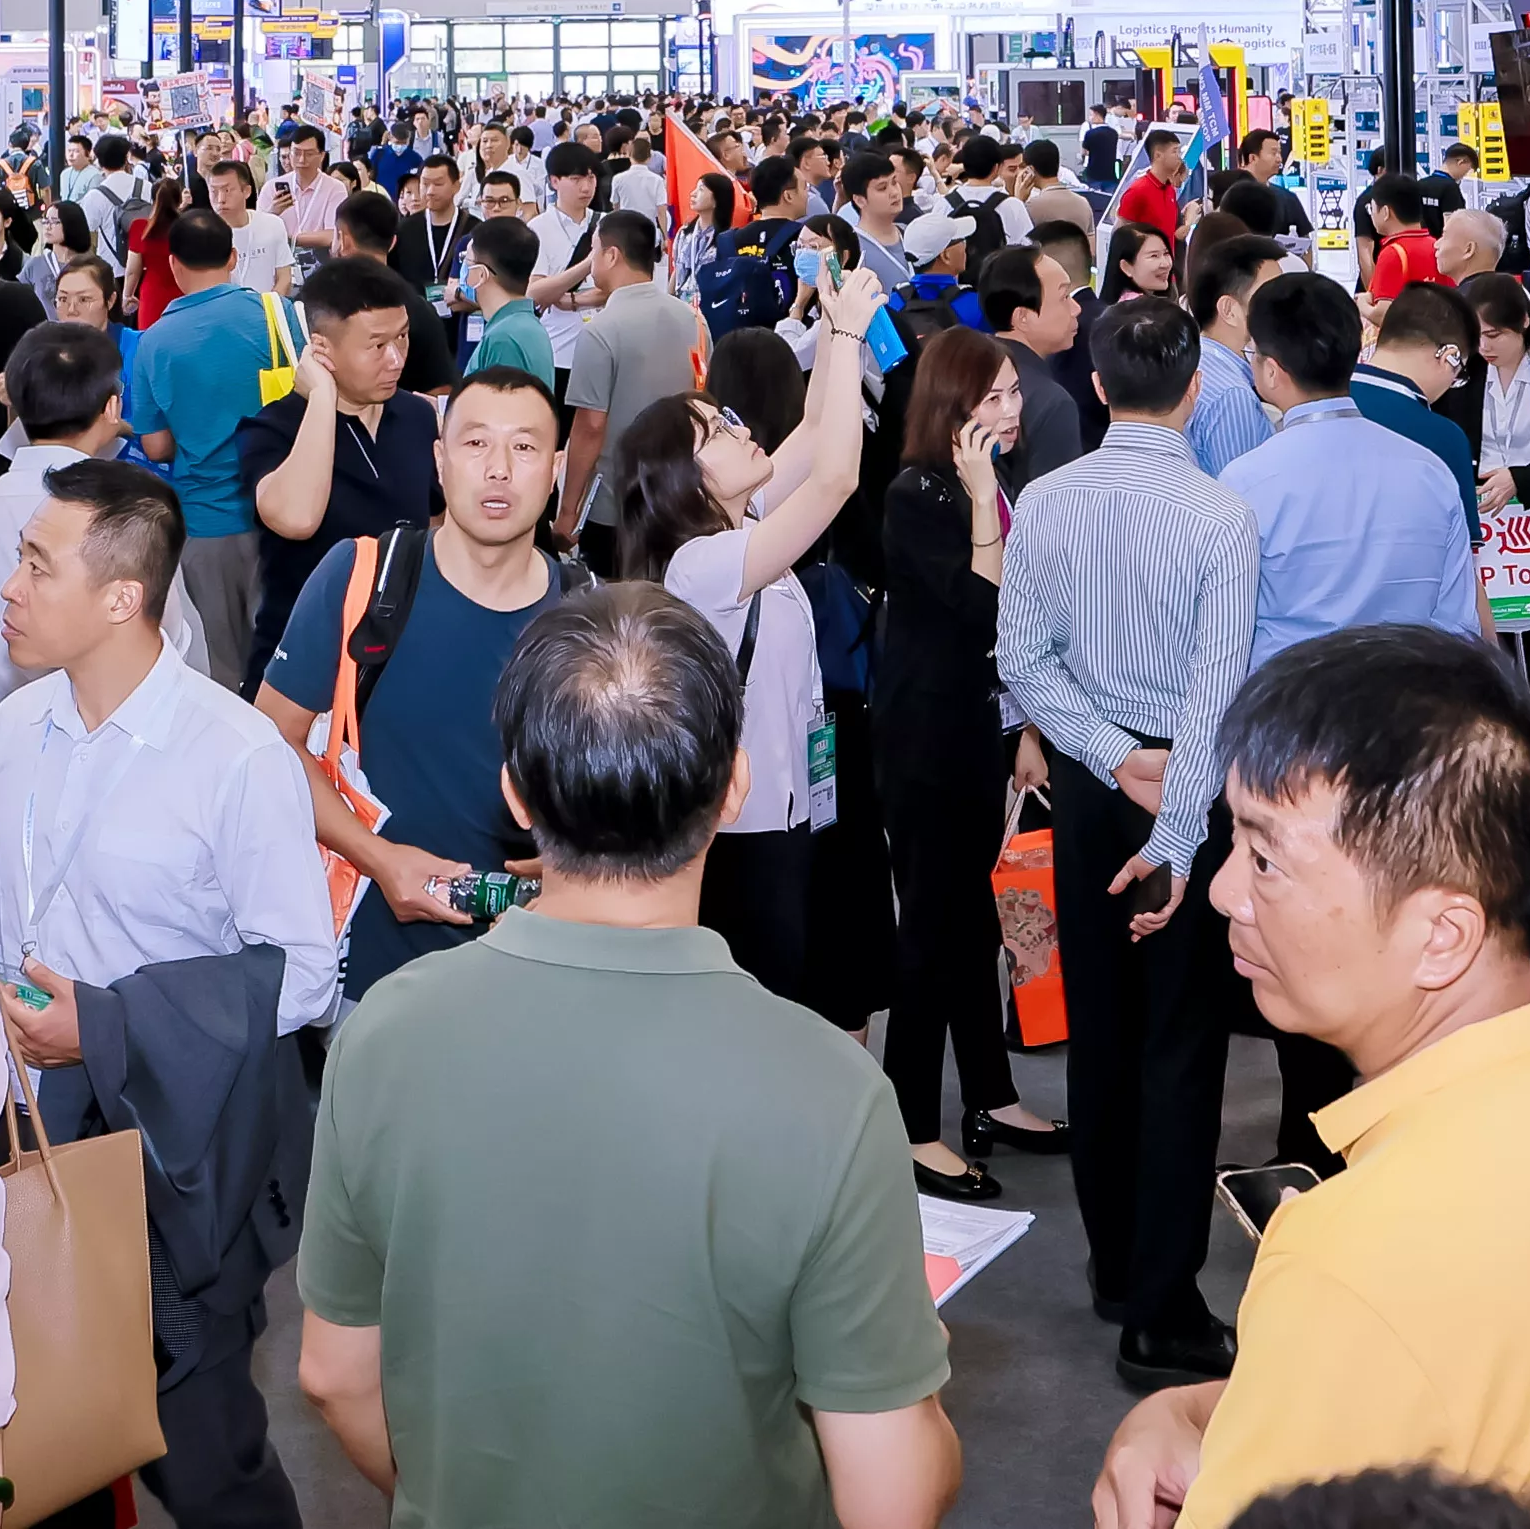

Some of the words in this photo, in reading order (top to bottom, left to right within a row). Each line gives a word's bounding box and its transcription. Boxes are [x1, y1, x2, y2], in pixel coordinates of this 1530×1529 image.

[1119, 24, 1168, 37] Logistics
[1170, 24, 1217, 36] Benets
[1219, 23, 1273, 37] Humanity
